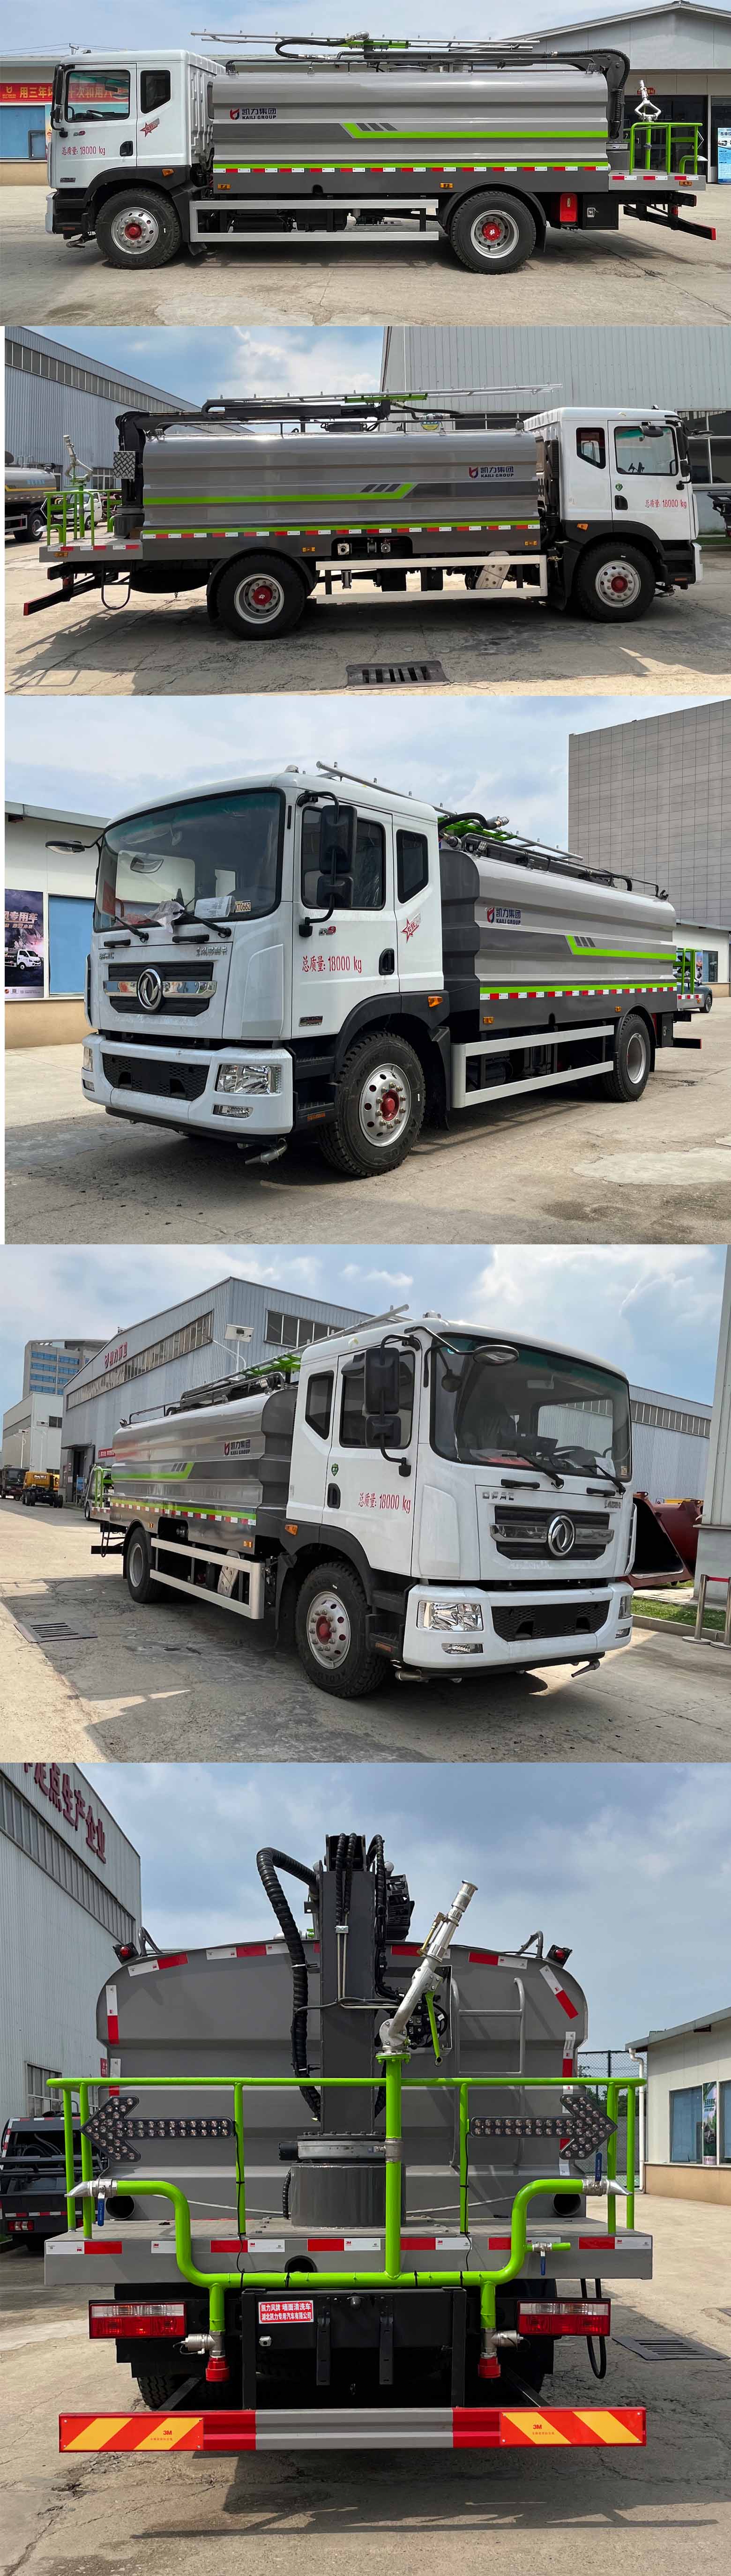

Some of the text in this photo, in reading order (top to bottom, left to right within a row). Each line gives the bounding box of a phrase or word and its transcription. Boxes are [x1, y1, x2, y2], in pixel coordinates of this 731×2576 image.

[80, 146, 96, 155] 18000
[99, 146, 105, 156] kg
[680, 499, 686, 508] kg
[496, 908, 521, 918] 凯力集团
[328, 956, 350, 971] 18000
[354, 956, 362, 973] kg
[380, 1494, 400, 1510] 18000
[403, 1496, 411, 1514] kg
[261, 2312, 312, 2321] 湖北凯力专用汽车有限公司
